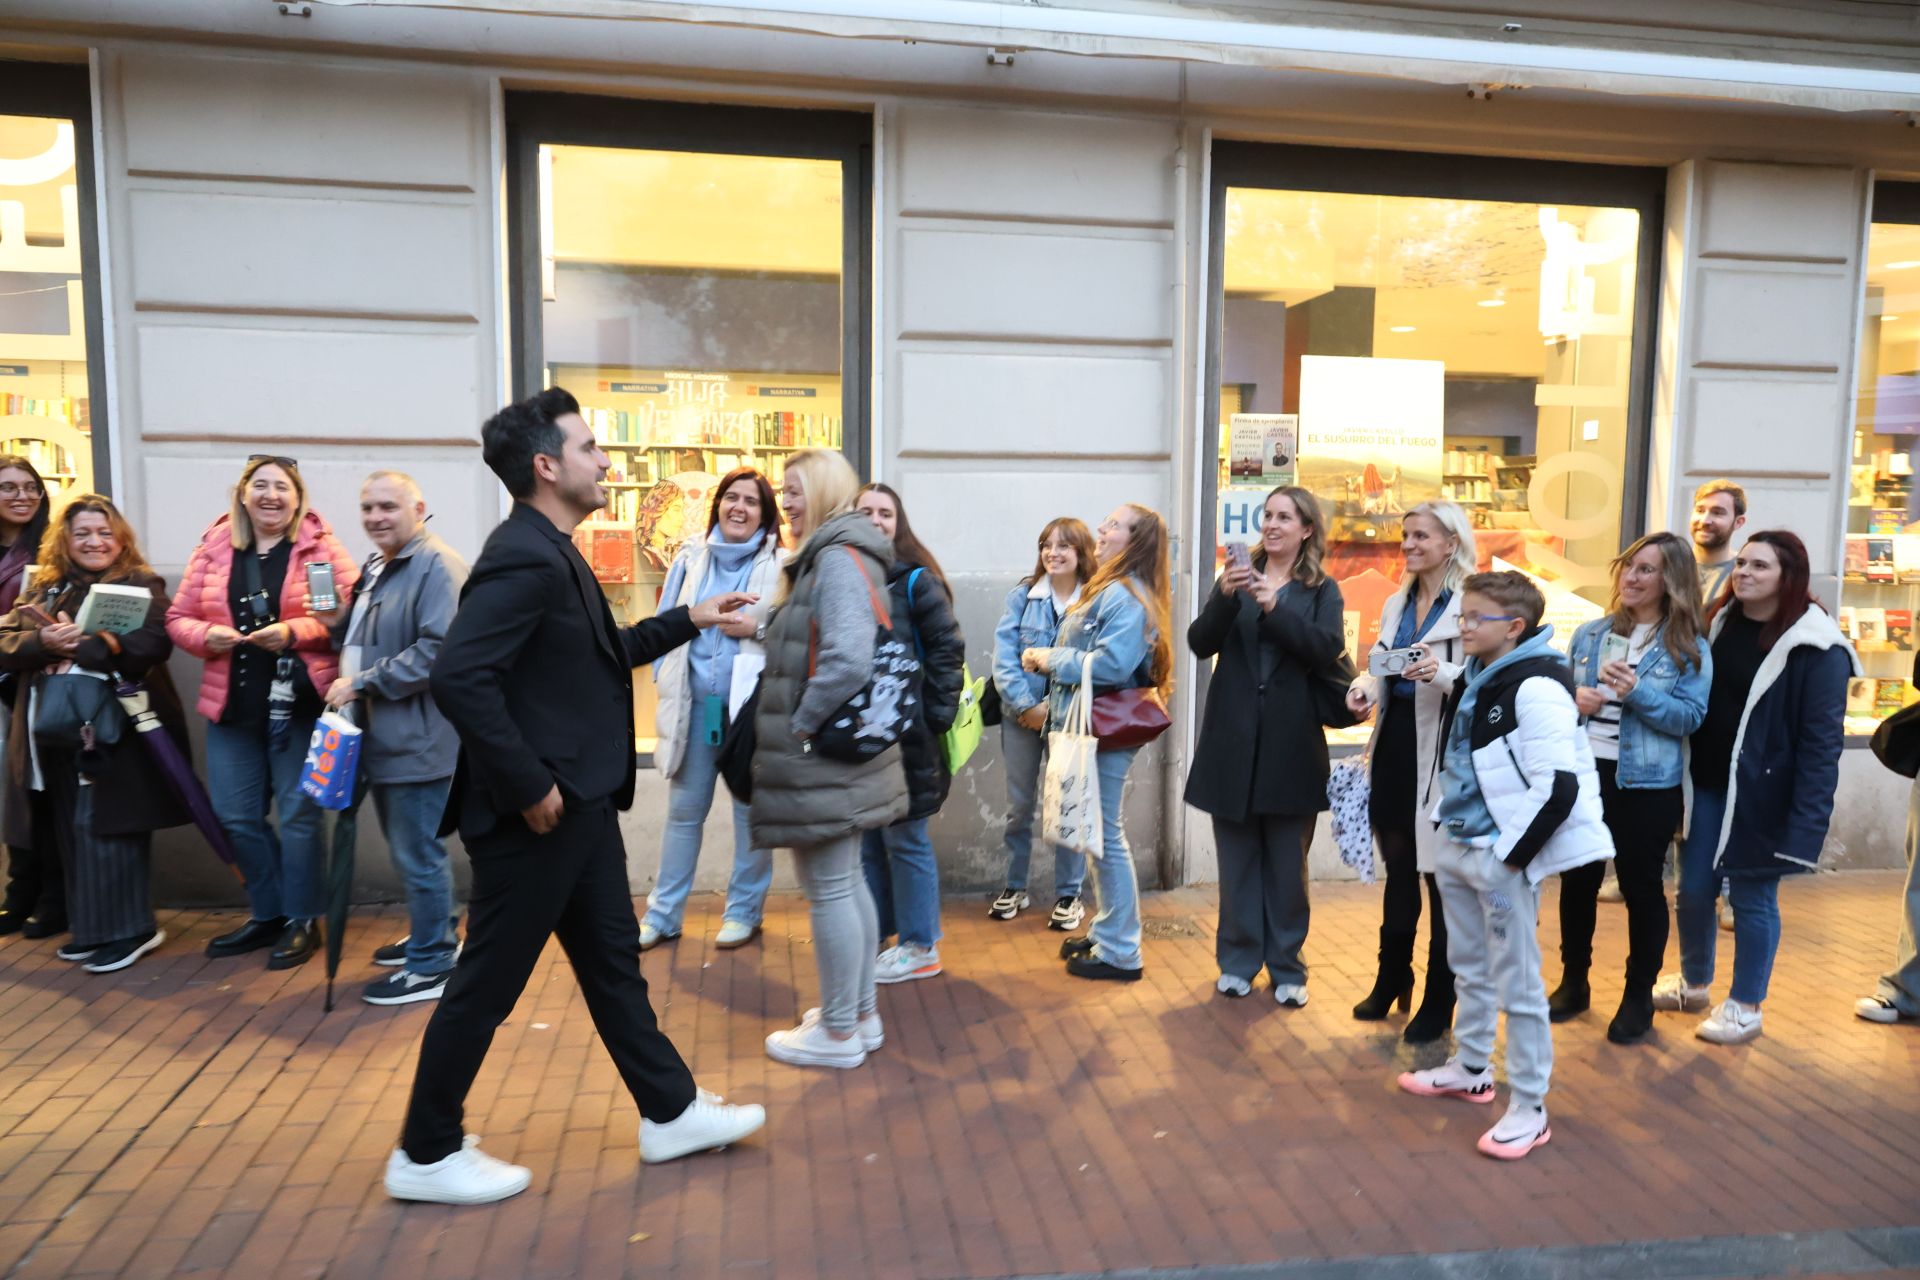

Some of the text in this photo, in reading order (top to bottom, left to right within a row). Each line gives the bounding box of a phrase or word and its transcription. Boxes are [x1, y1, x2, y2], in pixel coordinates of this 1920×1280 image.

[622, 384, 659, 392] NARRATIVA
[661, 379, 731, 408] HIJA
[769, 388, 806, 396] NARRATIVA
[1307, 433, 1437, 447] EL SUSURRO DEL FUEGO
[309, 729, 341, 786] leo
